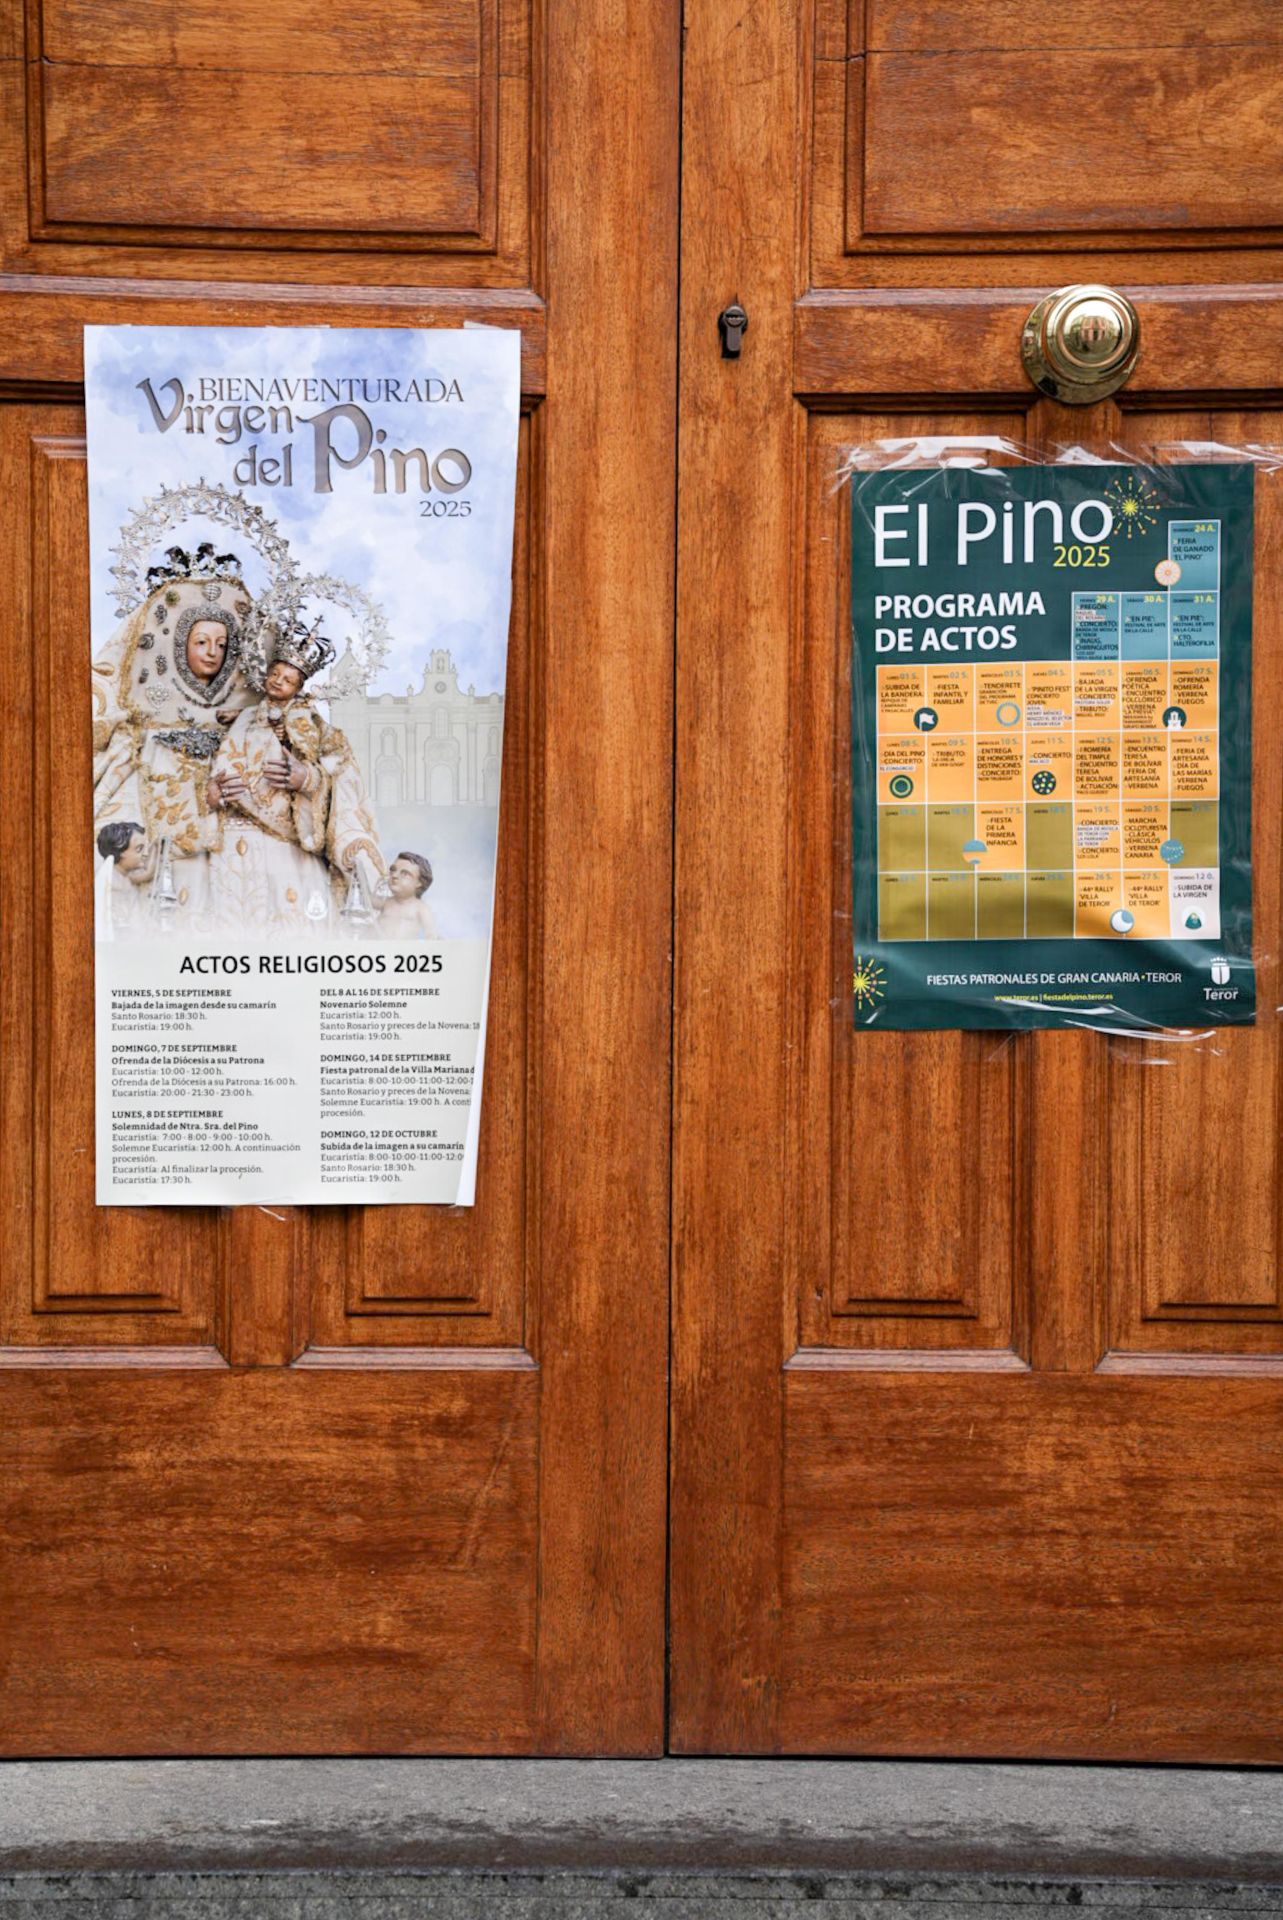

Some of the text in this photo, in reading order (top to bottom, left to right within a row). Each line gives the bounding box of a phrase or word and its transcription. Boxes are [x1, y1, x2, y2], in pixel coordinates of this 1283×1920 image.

[199, 378, 464, 402] BIENAVENTURADA
[136, 377, 295, 445] Virgen
[233, 403, 472, 494] del Pino
[420, 501, 471, 517] 2025
[875, 499, 1113, 567] El Pino
[1053, 546, 1110, 568] 2025
[875, 591, 1045, 619] PROGRAMA
[875, 626, 1017, 653] DE ACTOS
[180, 955, 443, 974] ACTOS RELIGIOSOS 2025
[927, 975, 966, 986] FIESTAS
[970, 974, 1037, 985] PATRONALES
[1040, 974, 1055, 984] DE
[1058, 973, 1089, 983] GRAN
[111, 989, 232, 998] VIERNES, 5 DE SEPTIEMBRE
[1203, 988, 1238, 1000] Teror
[111, 1001, 276, 1010] Bajada de la imagen desde su camarín
[111, 1012, 207, 1020] Santo Rosario: 18:30 h.
[112, 1045, 160, 1053] DOMINGO,
[349, 1066, 388, 1075] patronal
[111, 1078, 148, 1086] Ofrenda
[150, 1078, 160, 1086] de
[162, 1078, 170, 1086] la
[172, 1078, 206, 1086] Diócesis
[226, 1078, 262, 1086] Patrona:
[264, 1078, 287, 1086] 16:00
[289, 1078, 297, 1086] h.
[112, 1111, 145, 1119] LUNES,
[321, 1130, 368, 1138] DOMINGO,
[321, 1142, 351, 1150] Subida
[353, 1142, 363, 1150] de
[365, 1142, 373, 1150] la
[375, 1142, 408, 1151] imagen
[428, 1142, 464, 1150] camarín
[112, 1155, 157, 1164] procesión.
